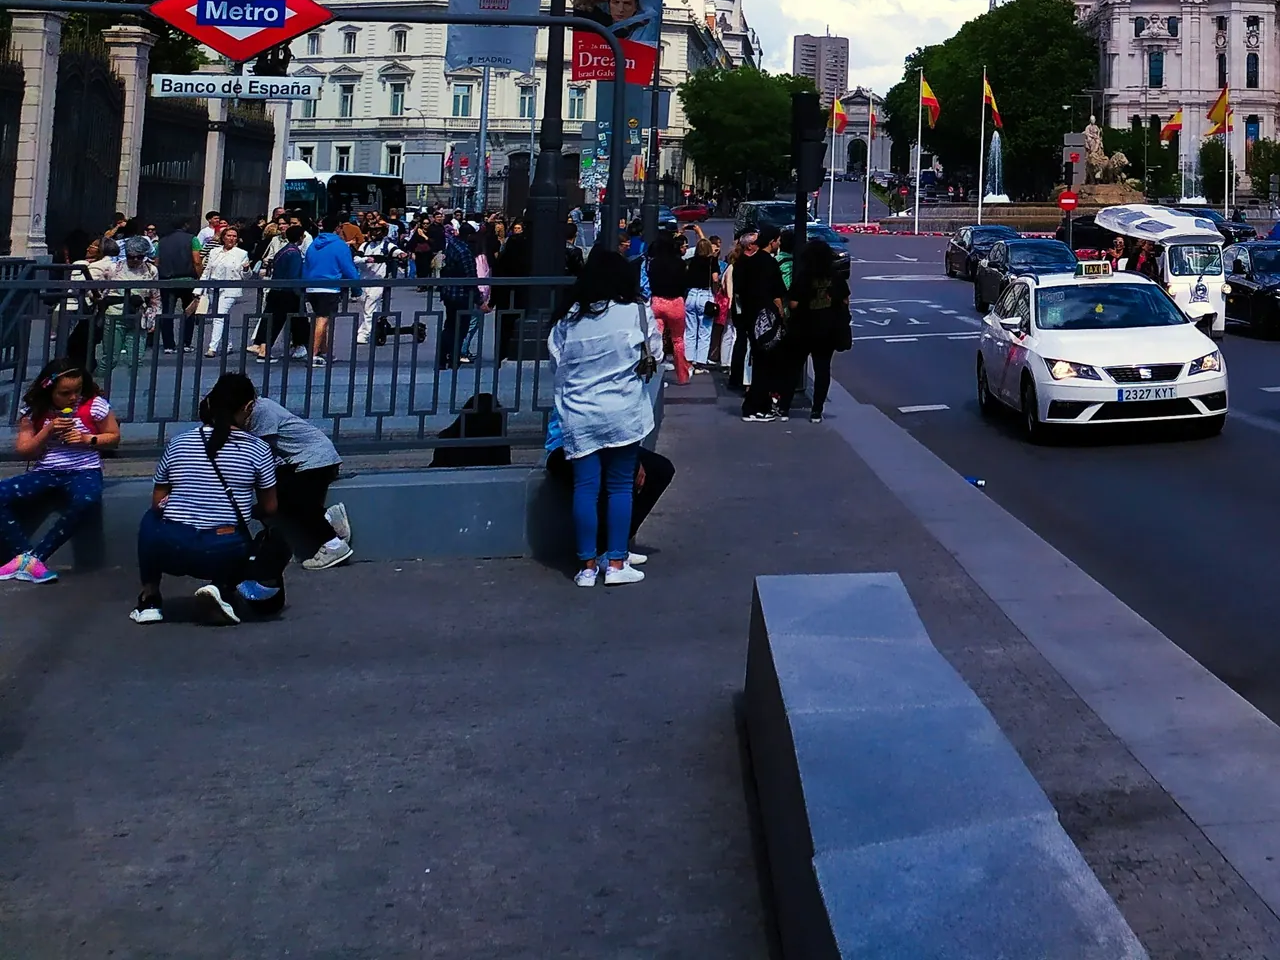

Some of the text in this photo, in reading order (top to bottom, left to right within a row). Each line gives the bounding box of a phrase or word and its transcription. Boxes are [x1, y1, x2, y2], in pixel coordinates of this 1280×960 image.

[205, 0, 279, 22] Metro
[477, 56, 512, 65] MADRID
[596, 69, 615, 77] Galv
[161, 78, 311, 97] Banco de España
[1085, 265, 1101, 274] TAXI
[1125, 387, 1175, 400] 2327 KYT
